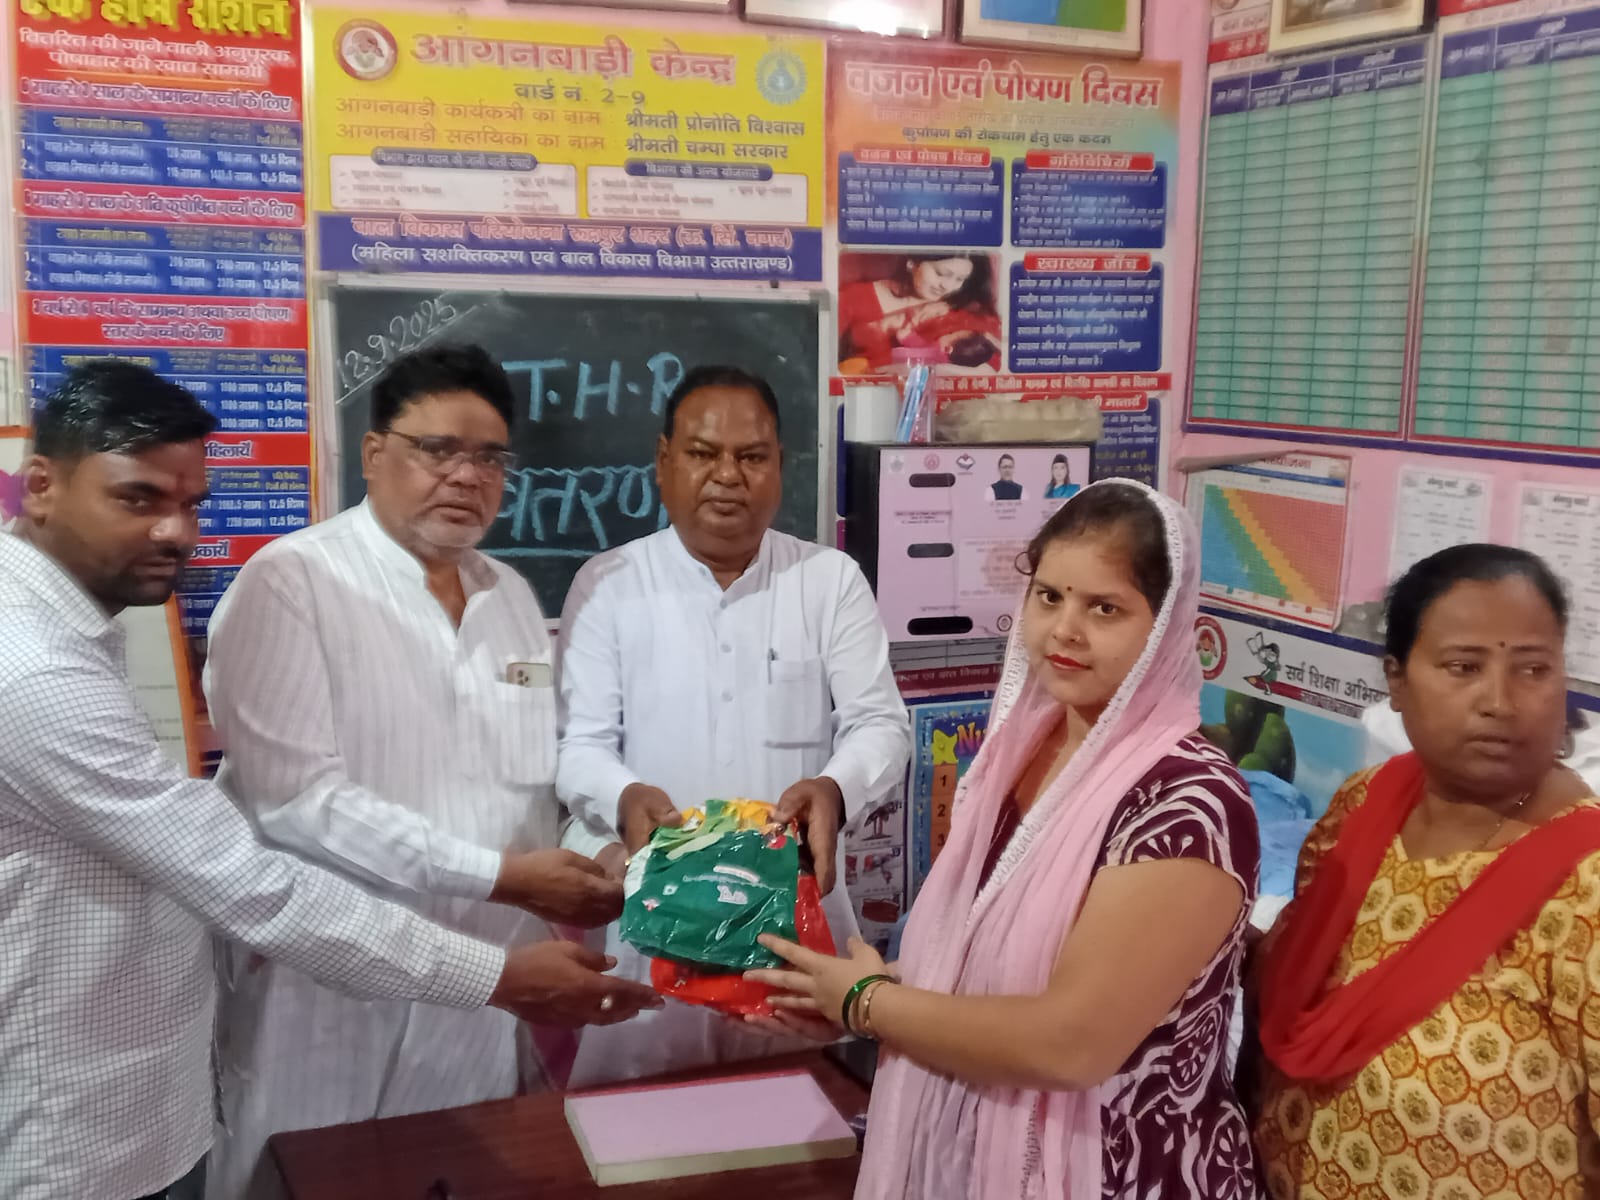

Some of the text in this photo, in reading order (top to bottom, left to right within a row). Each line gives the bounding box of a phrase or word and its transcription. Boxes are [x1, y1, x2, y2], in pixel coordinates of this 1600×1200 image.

[48, 49, 121, 68] पोषाहार
[124, 54, 151, 70] की
[90, 33, 118, 49] की
[165, 41, 209, 57] वाली
[215, 46, 291, 64] अनुपूरक
[647, 37, 737, 85] केन्द्र
[92, 83, 125, 101] साल
[260, 90, 293, 112] लिए
[514, 78, 555, 101] वार्ड
[846, 61, 935, 100] वजन
[937, 58, 992, 101] एवं
[993, 60, 1074, 105] पोषण
[1080, 62, 1163, 109] दिवस
[532, 106, 556, 123] का
[563, 109, 602, 126] नाम
[626, 107, 678, 131] श्रीमती
[747, 114, 806, 137] विश्वास
[953, 125, 972, 141] की
[1053, 133, 1075, 146] एक
[1078, 133, 1112, 146] कदम
[444, 125, 528, 147] सहायिका
[536, 132, 560, 149] का
[567, 135, 605, 151] नाम
[626, 133, 679, 155] श्रीमती
[685, 139, 726, 157] चम्पा
[732, 142, 789, 160] सरकार
[88, 193, 117, 210] साल
[267, 197, 296, 219] लिए
[400, 213, 465, 238] विकास
[468, 215, 565, 241] परियोजना
[351, 241, 794, 272] (महिला सशक्तिकरण एवं बाल विकास विभाग उत्तराखण्ड)
[198, 321, 225, 341] लिए
[1285, 661, 1307, 684] सर्व
[1309, 665, 1340, 695] शिक्षा
[939, 774, 947, 787] 1
[937, 804, 946, 818] 2
